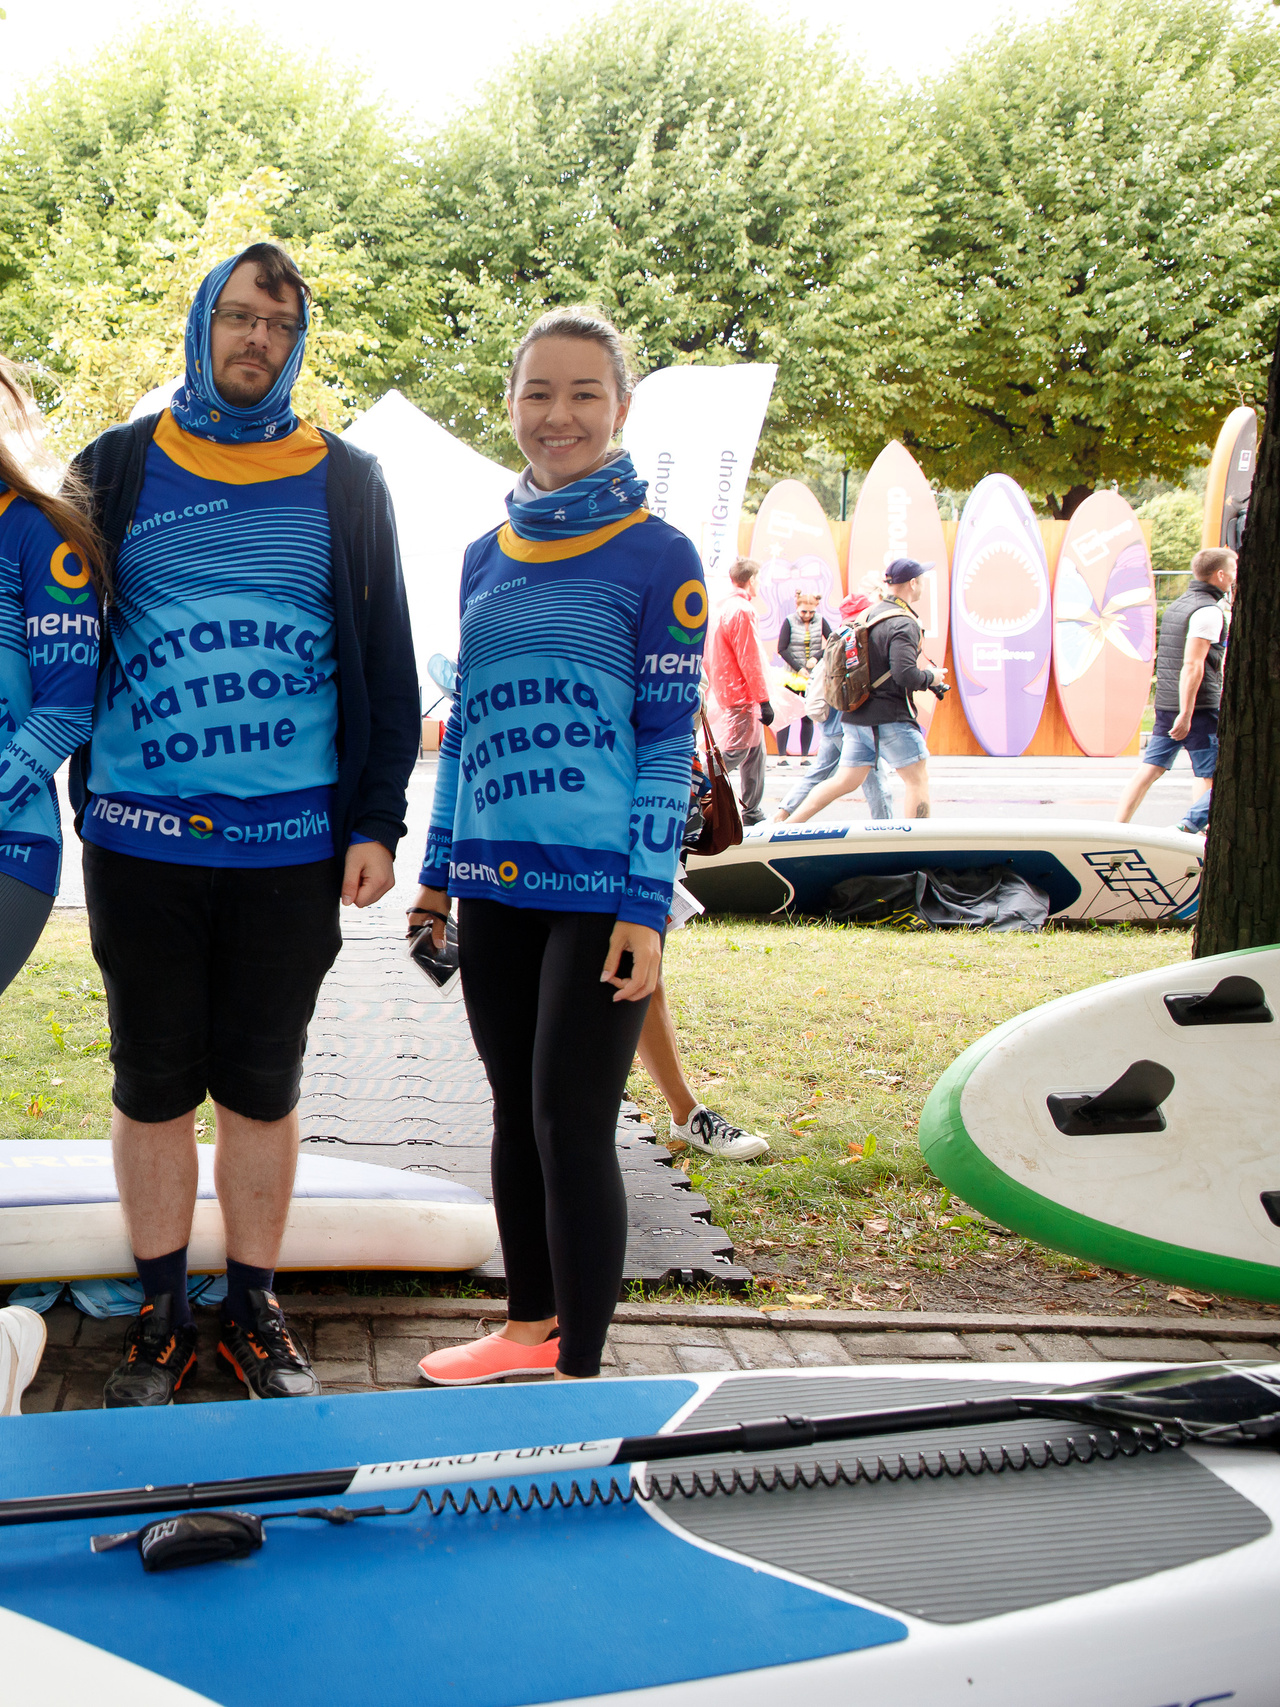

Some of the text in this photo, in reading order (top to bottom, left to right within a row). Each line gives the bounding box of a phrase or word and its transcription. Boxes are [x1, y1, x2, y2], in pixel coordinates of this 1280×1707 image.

[106, 619, 321, 712] Доставка
[130, 685, 183, 732] на
[140, 717, 297, 771] волне
[461, 714, 617, 785] на твоей
[473, 766, 586, 815] волне
[91, 798, 183, 838] лента
[222, 809, 331, 844] онлайн
[523, 870, 626, 894] онлайн
